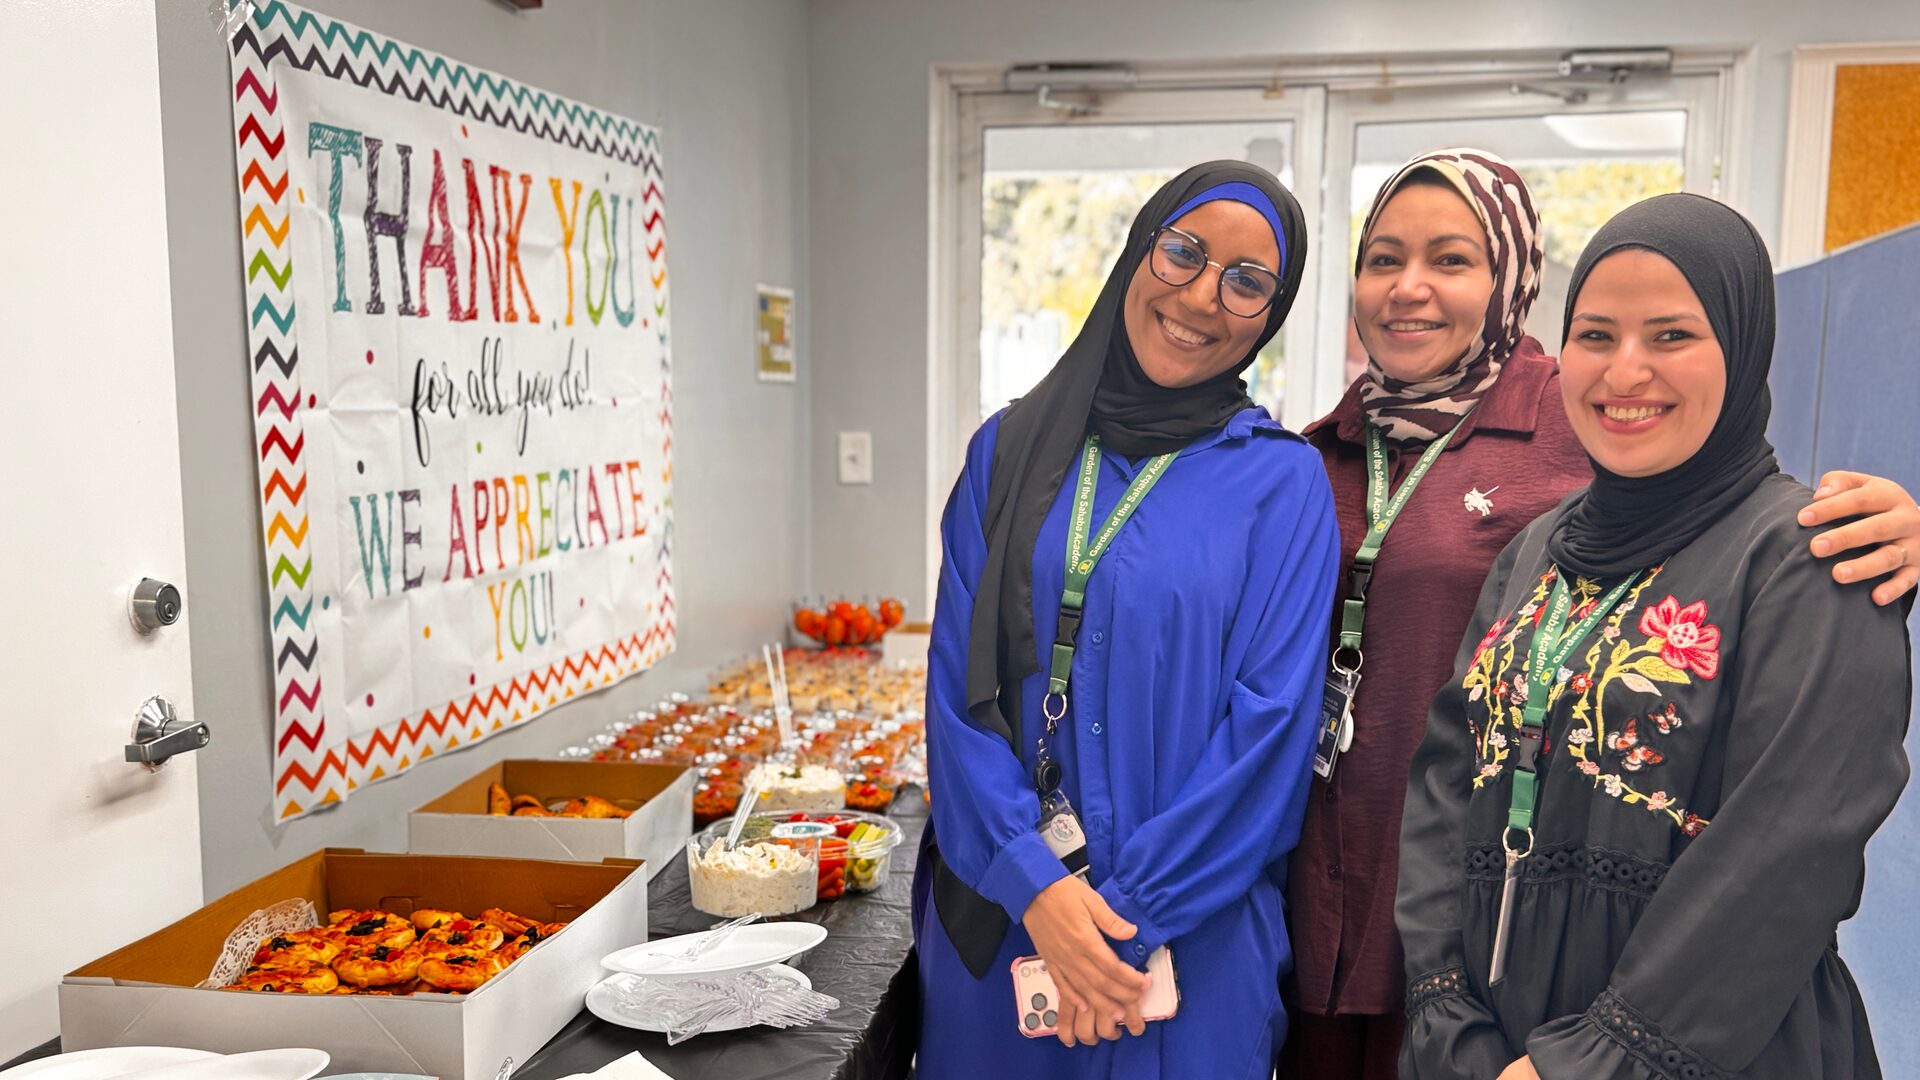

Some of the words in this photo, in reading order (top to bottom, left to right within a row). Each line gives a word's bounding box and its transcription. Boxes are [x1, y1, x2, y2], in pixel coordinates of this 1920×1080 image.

[308, 122, 541, 323] THANK
[549, 178, 635, 327] YOU
[411, 358, 461, 467] for
[467, 341, 508, 416] all
[516, 369, 553, 456] you
[559, 337, 593, 411] do!
[1084, 477, 1092, 485] of
[1085, 446, 1098, 477] Garden
[1373, 451, 1382, 459] of
[1076, 501, 1088, 531] Sahaba
[1081, 487, 1091, 500] the
[1090, 527, 1114, 556] Garden
[1112, 516, 1121, 526] of
[1117, 503, 1131, 517] the
[1127, 474, 1153, 502] Sahaba
[1386, 486, 1410, 517] Garden
[1408, 477, 1417, 486] of
[1414, 463, 1427, 477] the
[349, 489, 426, 600] WE
[442, 461, 648, 583] APPRECIATE
[487, 570, 557, 662] YOU!
[1545, 594, 1569, 632] Sahaba
[1552, 629, 1585, 663] Garden
[1584, 617, 1595, 627] of
[1593, 601, 1609, 616] the
